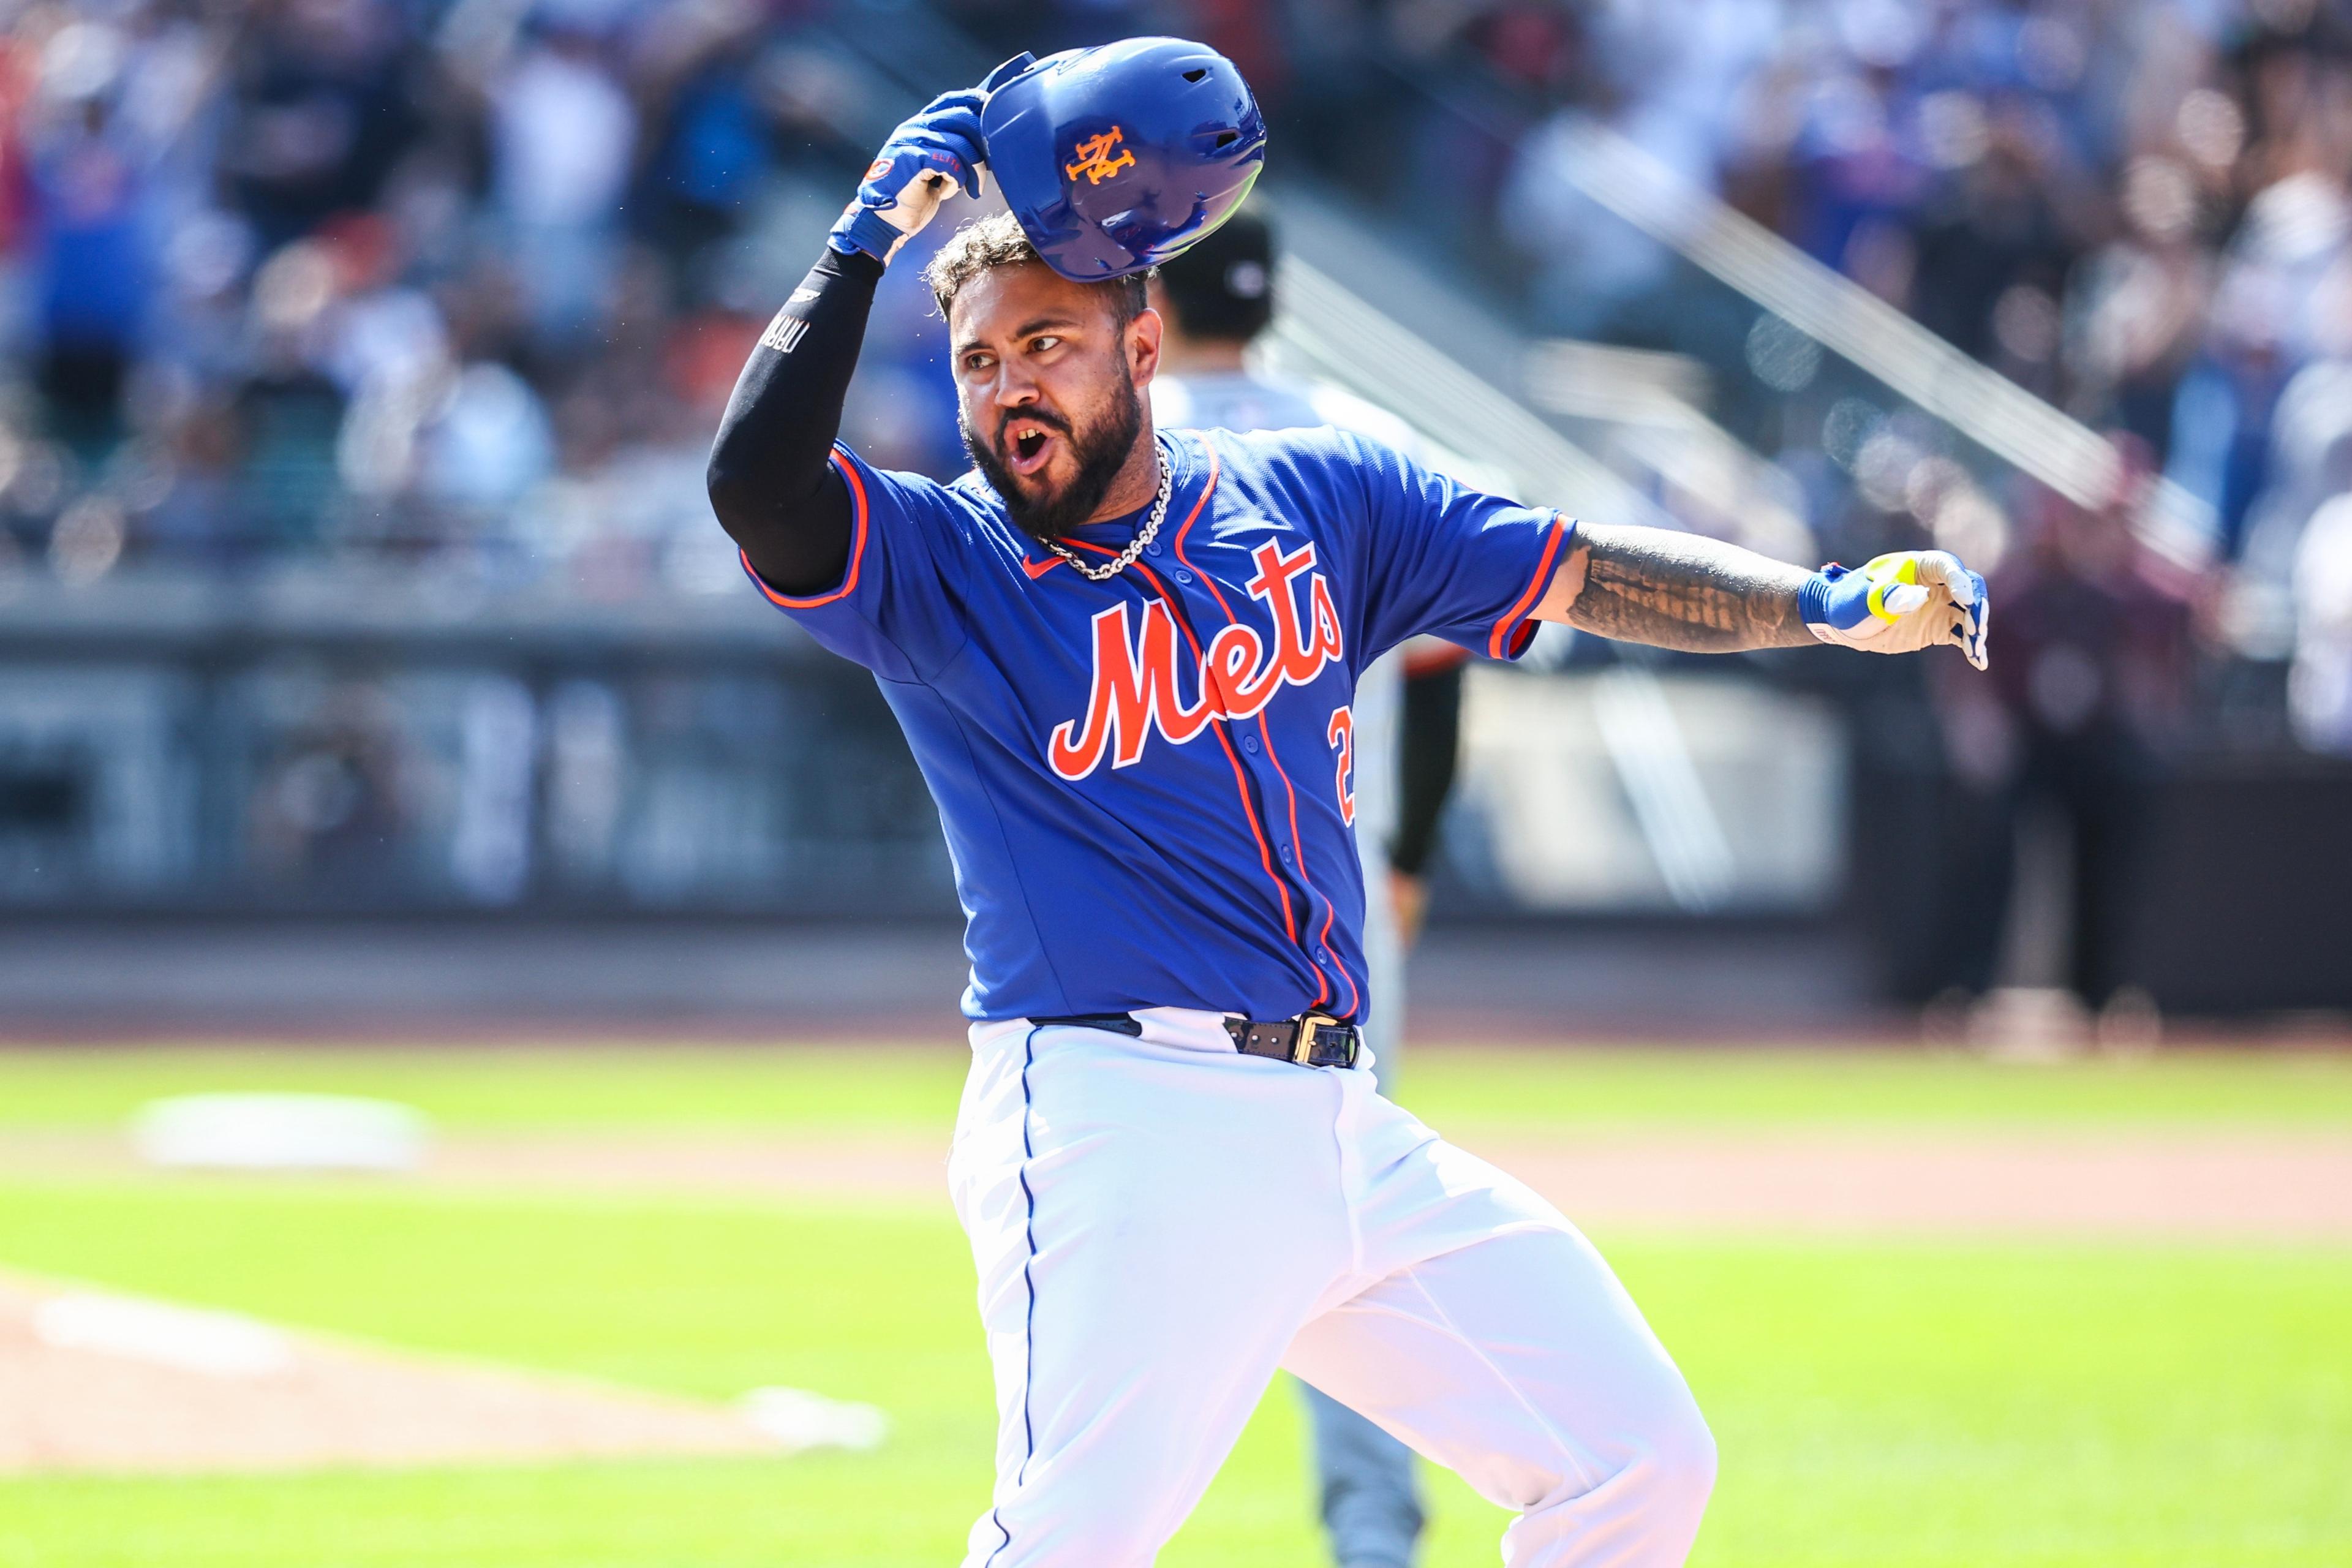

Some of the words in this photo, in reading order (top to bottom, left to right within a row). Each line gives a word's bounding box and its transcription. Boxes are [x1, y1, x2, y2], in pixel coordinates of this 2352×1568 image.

[932, 152, 960, 172] ELITE
[1047, 536, 1343, 781] Mets
[1327, 705, 1355, 828] 2
